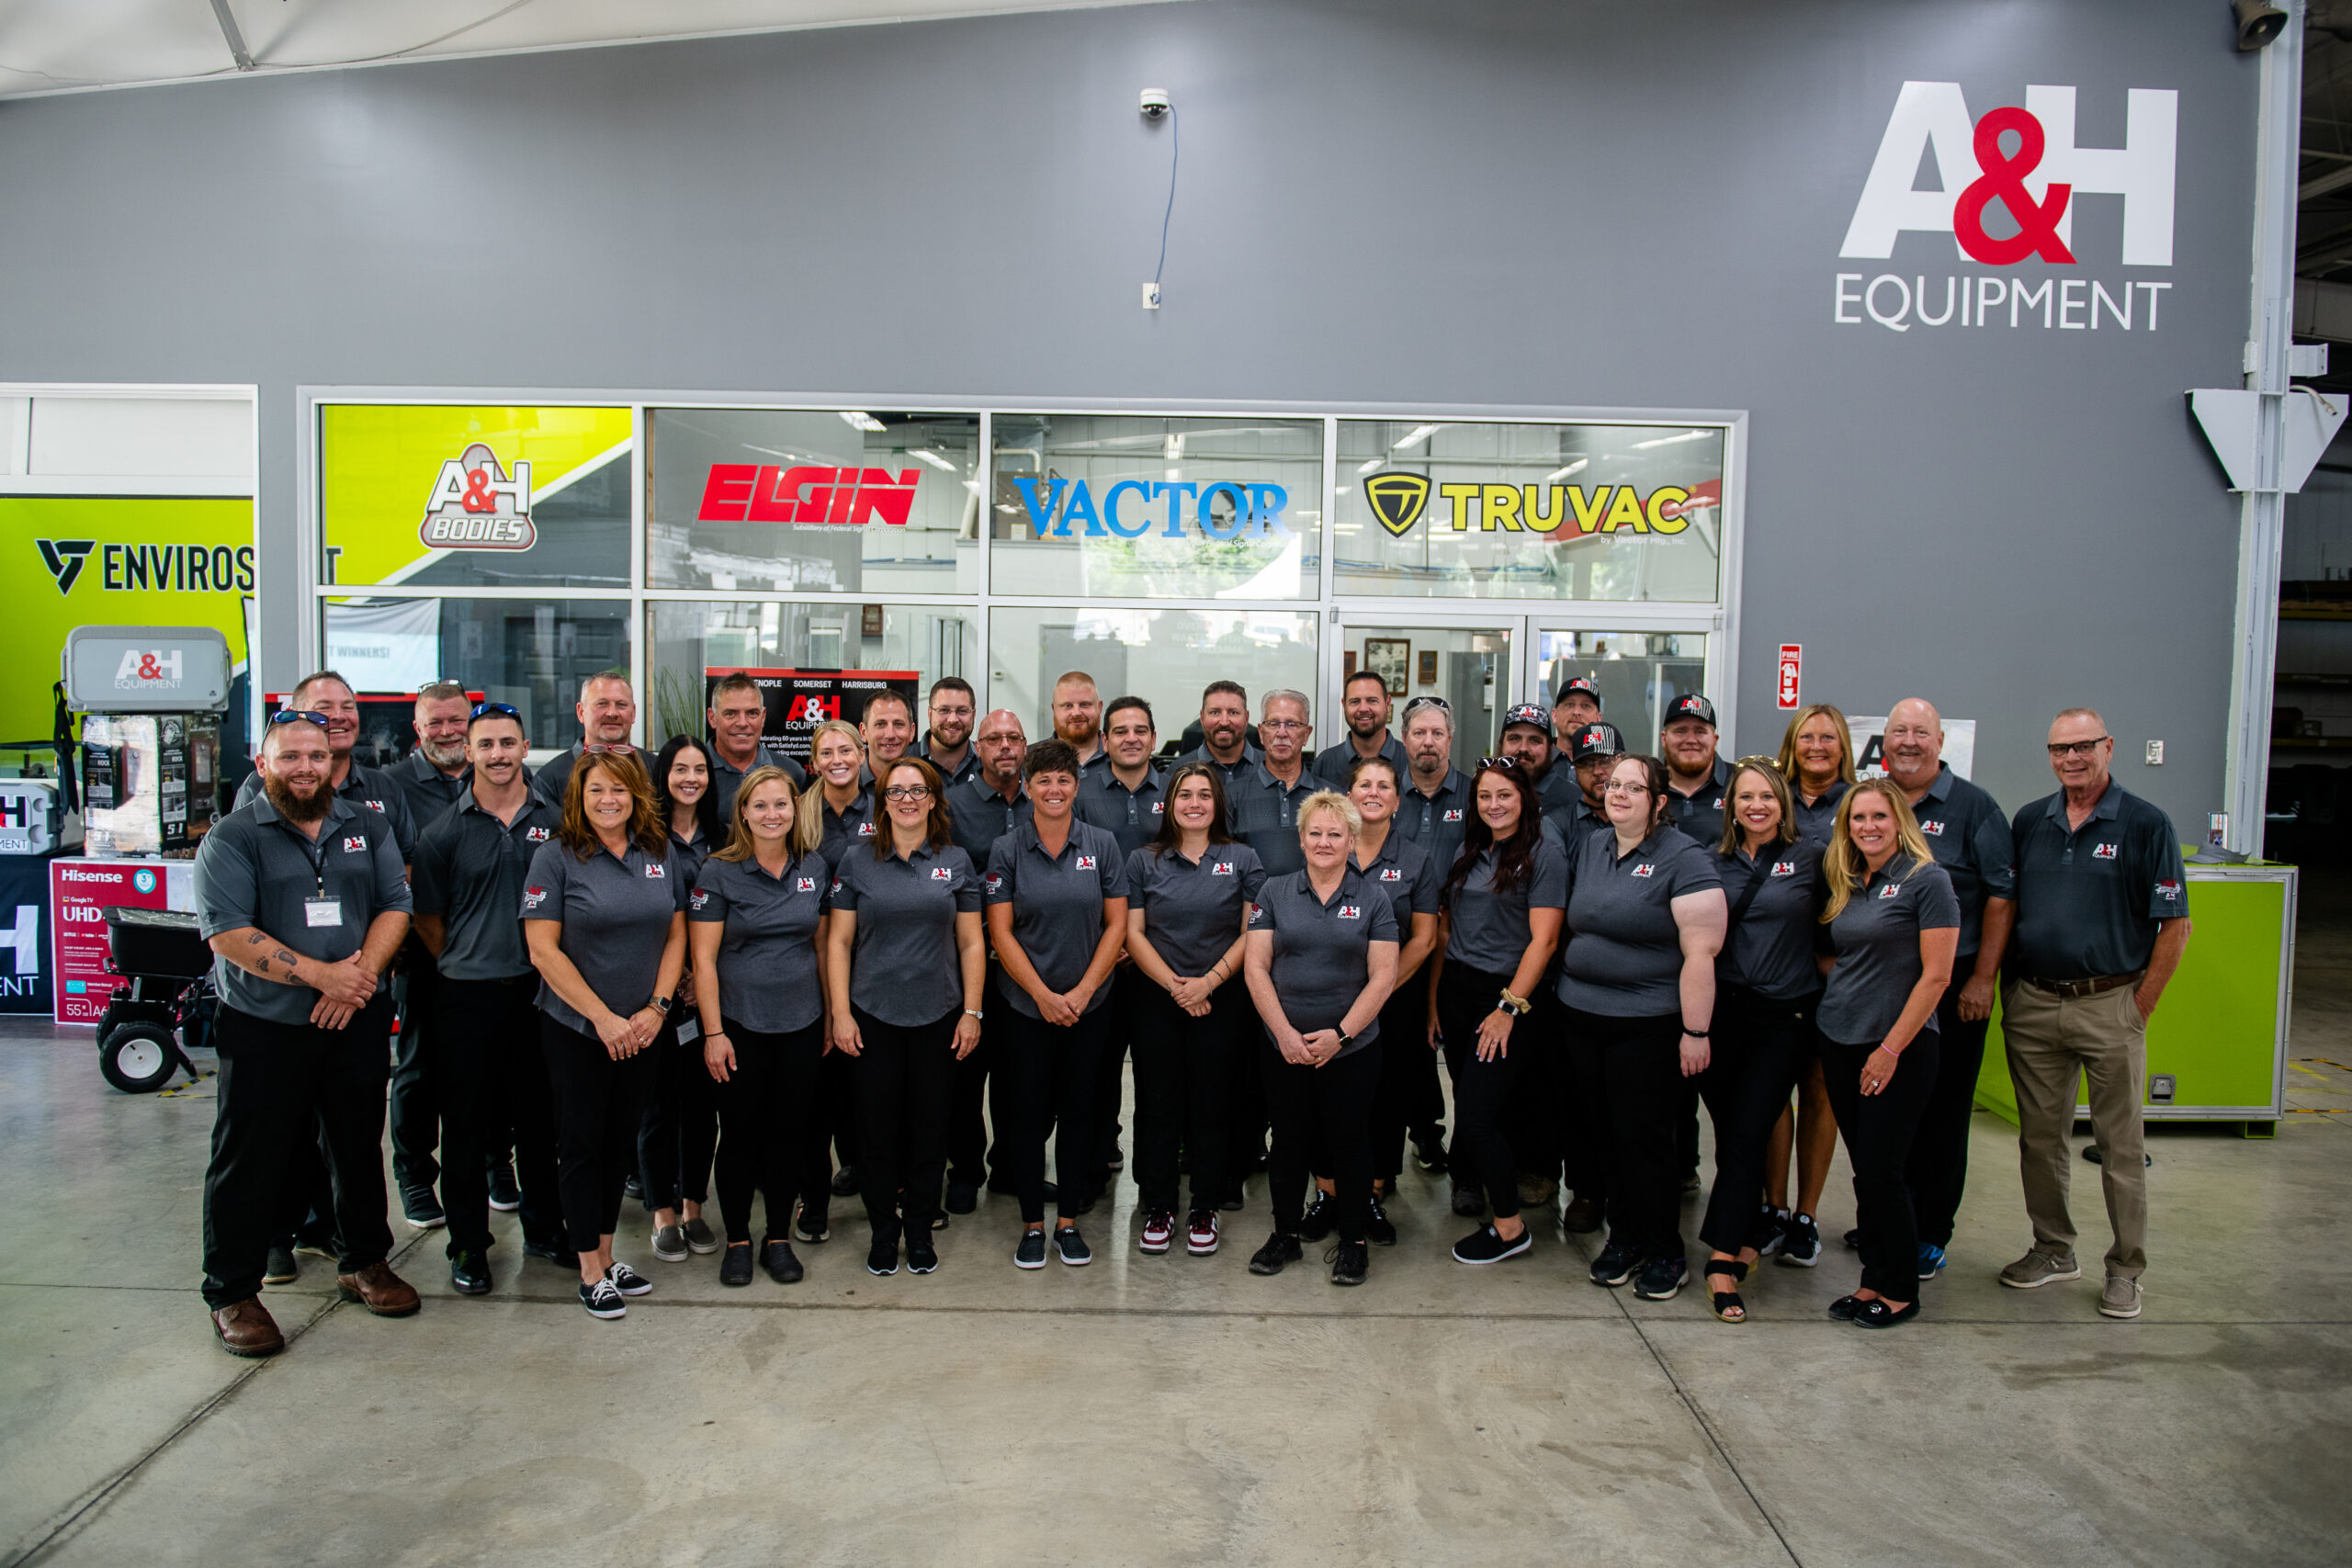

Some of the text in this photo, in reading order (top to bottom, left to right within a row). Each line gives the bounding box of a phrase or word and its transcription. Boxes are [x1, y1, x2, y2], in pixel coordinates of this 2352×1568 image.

[1838, 81, 2178, 266] A&H
[1835, 273, 2172, 332] EQUIPMENT
[427, 460, 530, 513] A&H
[697, 464, 922, 525] ELGIN
[1012, 478, 1296, 539] VACTOR
[1440, 482, 1690, 535] TRUVAC
[431, 517, 525, 542] BODIES
[1600, 536, 1611, 544] by
[1614, 536, 1647, 544] Vactor
[337, 647, 390, 659] WINNERS!
[116, 649, 183, 680] A&H
[114, 680, 184, 690] EQUIPMENT
[793, 680, 832, 688] SOMERSET
[842, 681, 887, 689] HARRISBURG
[786, 694, 841, 722] A&H
[786, 721, 828, 730] EQUIPM
[526, 827, 549, 840] A&H
[2094, 843, 2118, 856] A&H
[1077, 856, 1095, 866] A&H
[646, 864, 664, 875] A&H
[932, 868, 952, 877] A&H
[1213, 863, 1233, 873] A&H
[1381, 869, 1401, 879] A&H
[1632, 864, 1655, 875] A&H
[1772, 863, 1794, 873] A&H
[62, 869, 123, 883] Hisense
[797, 877, 815, 888] A&H
[62, 906, 102, 922] UHD
[1339, 906, 1360, 916] A&H
[66, 1004, 81, 1016] 55
